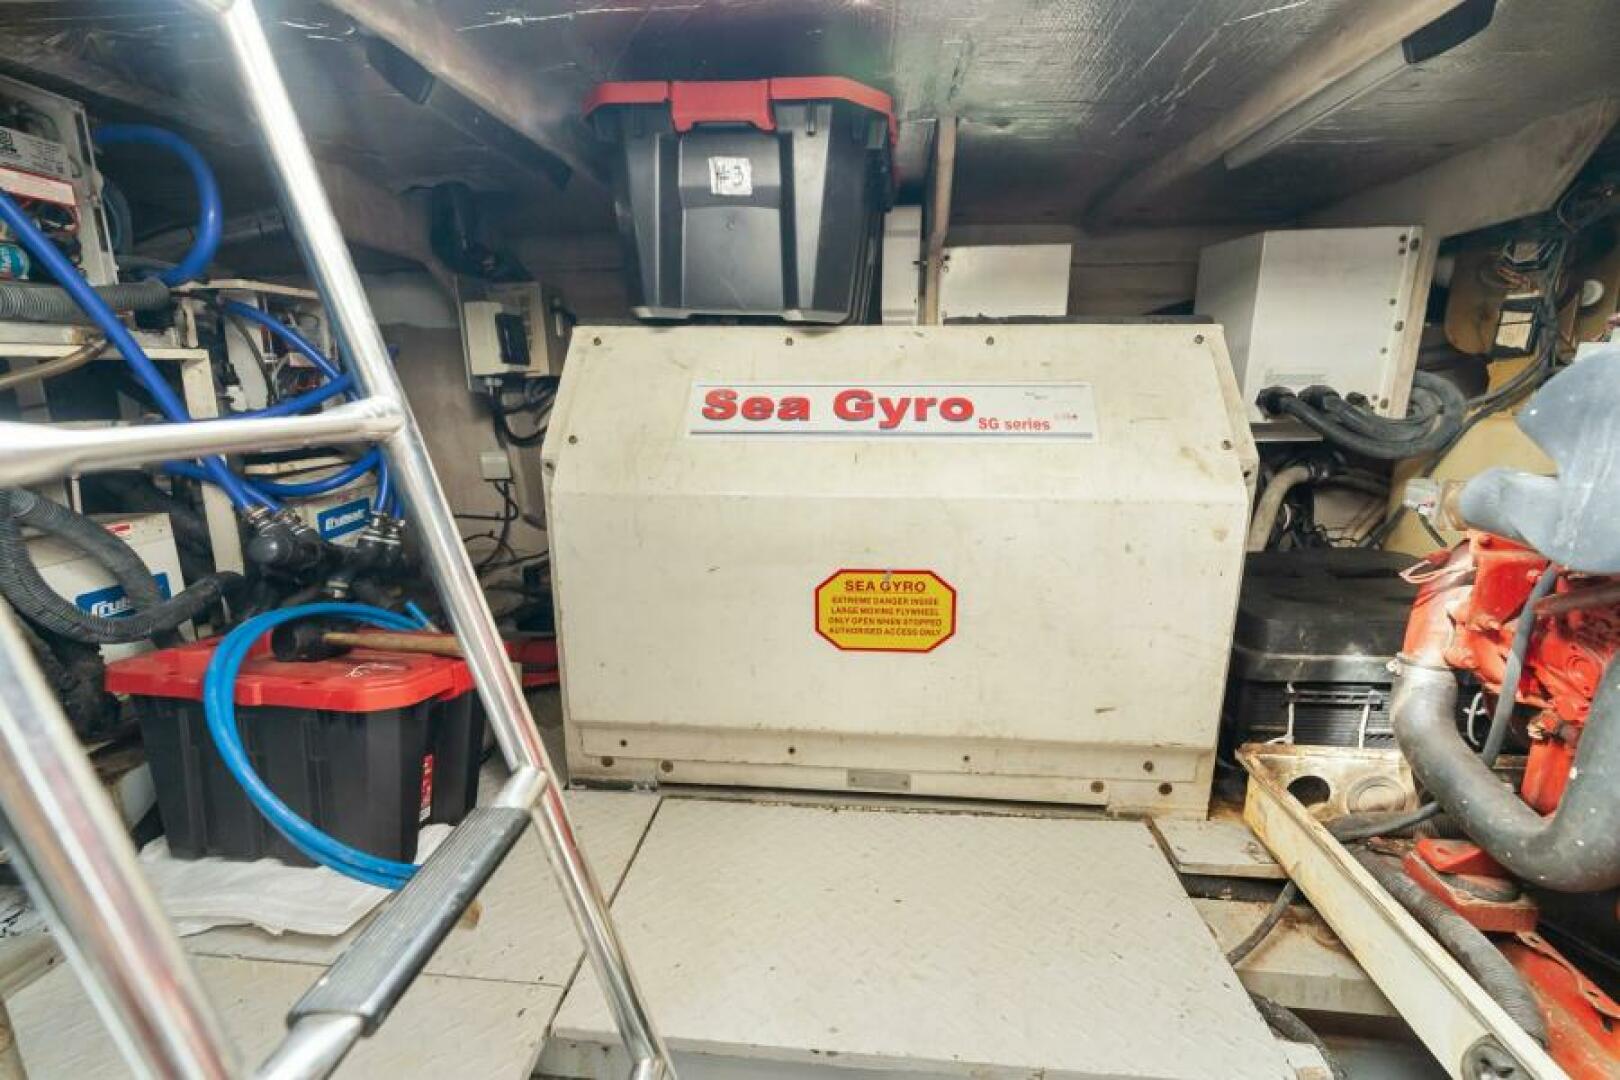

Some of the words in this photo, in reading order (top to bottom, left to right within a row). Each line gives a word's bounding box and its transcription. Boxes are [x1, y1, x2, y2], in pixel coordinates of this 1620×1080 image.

[701, 389, 811, 422] Sea
[832, 389, 975, 429] Gyro
[978, 417, 999, 431] SG
[1004, 417, 1051, 431] series
[845, 580, 876, 592] SEA
[880, 580, 926, 593] GYRO
[832, 597, 872, 606] EXTREME
[873, 597, 909, 606] DANGER
[831, 607, 859, 616] LARGE
[896, 607, 940, 616] FLYWHEEL
[828, 617, 850, 626] ONLY
[851, 617, 875, 626] OPEN
[876, 618, 901, 626] WHEN
[903, 618, 942, 626] STOPPED
[884, 627, 918, 636] ACCESS
[920, 627, 942, 636] ONLY
